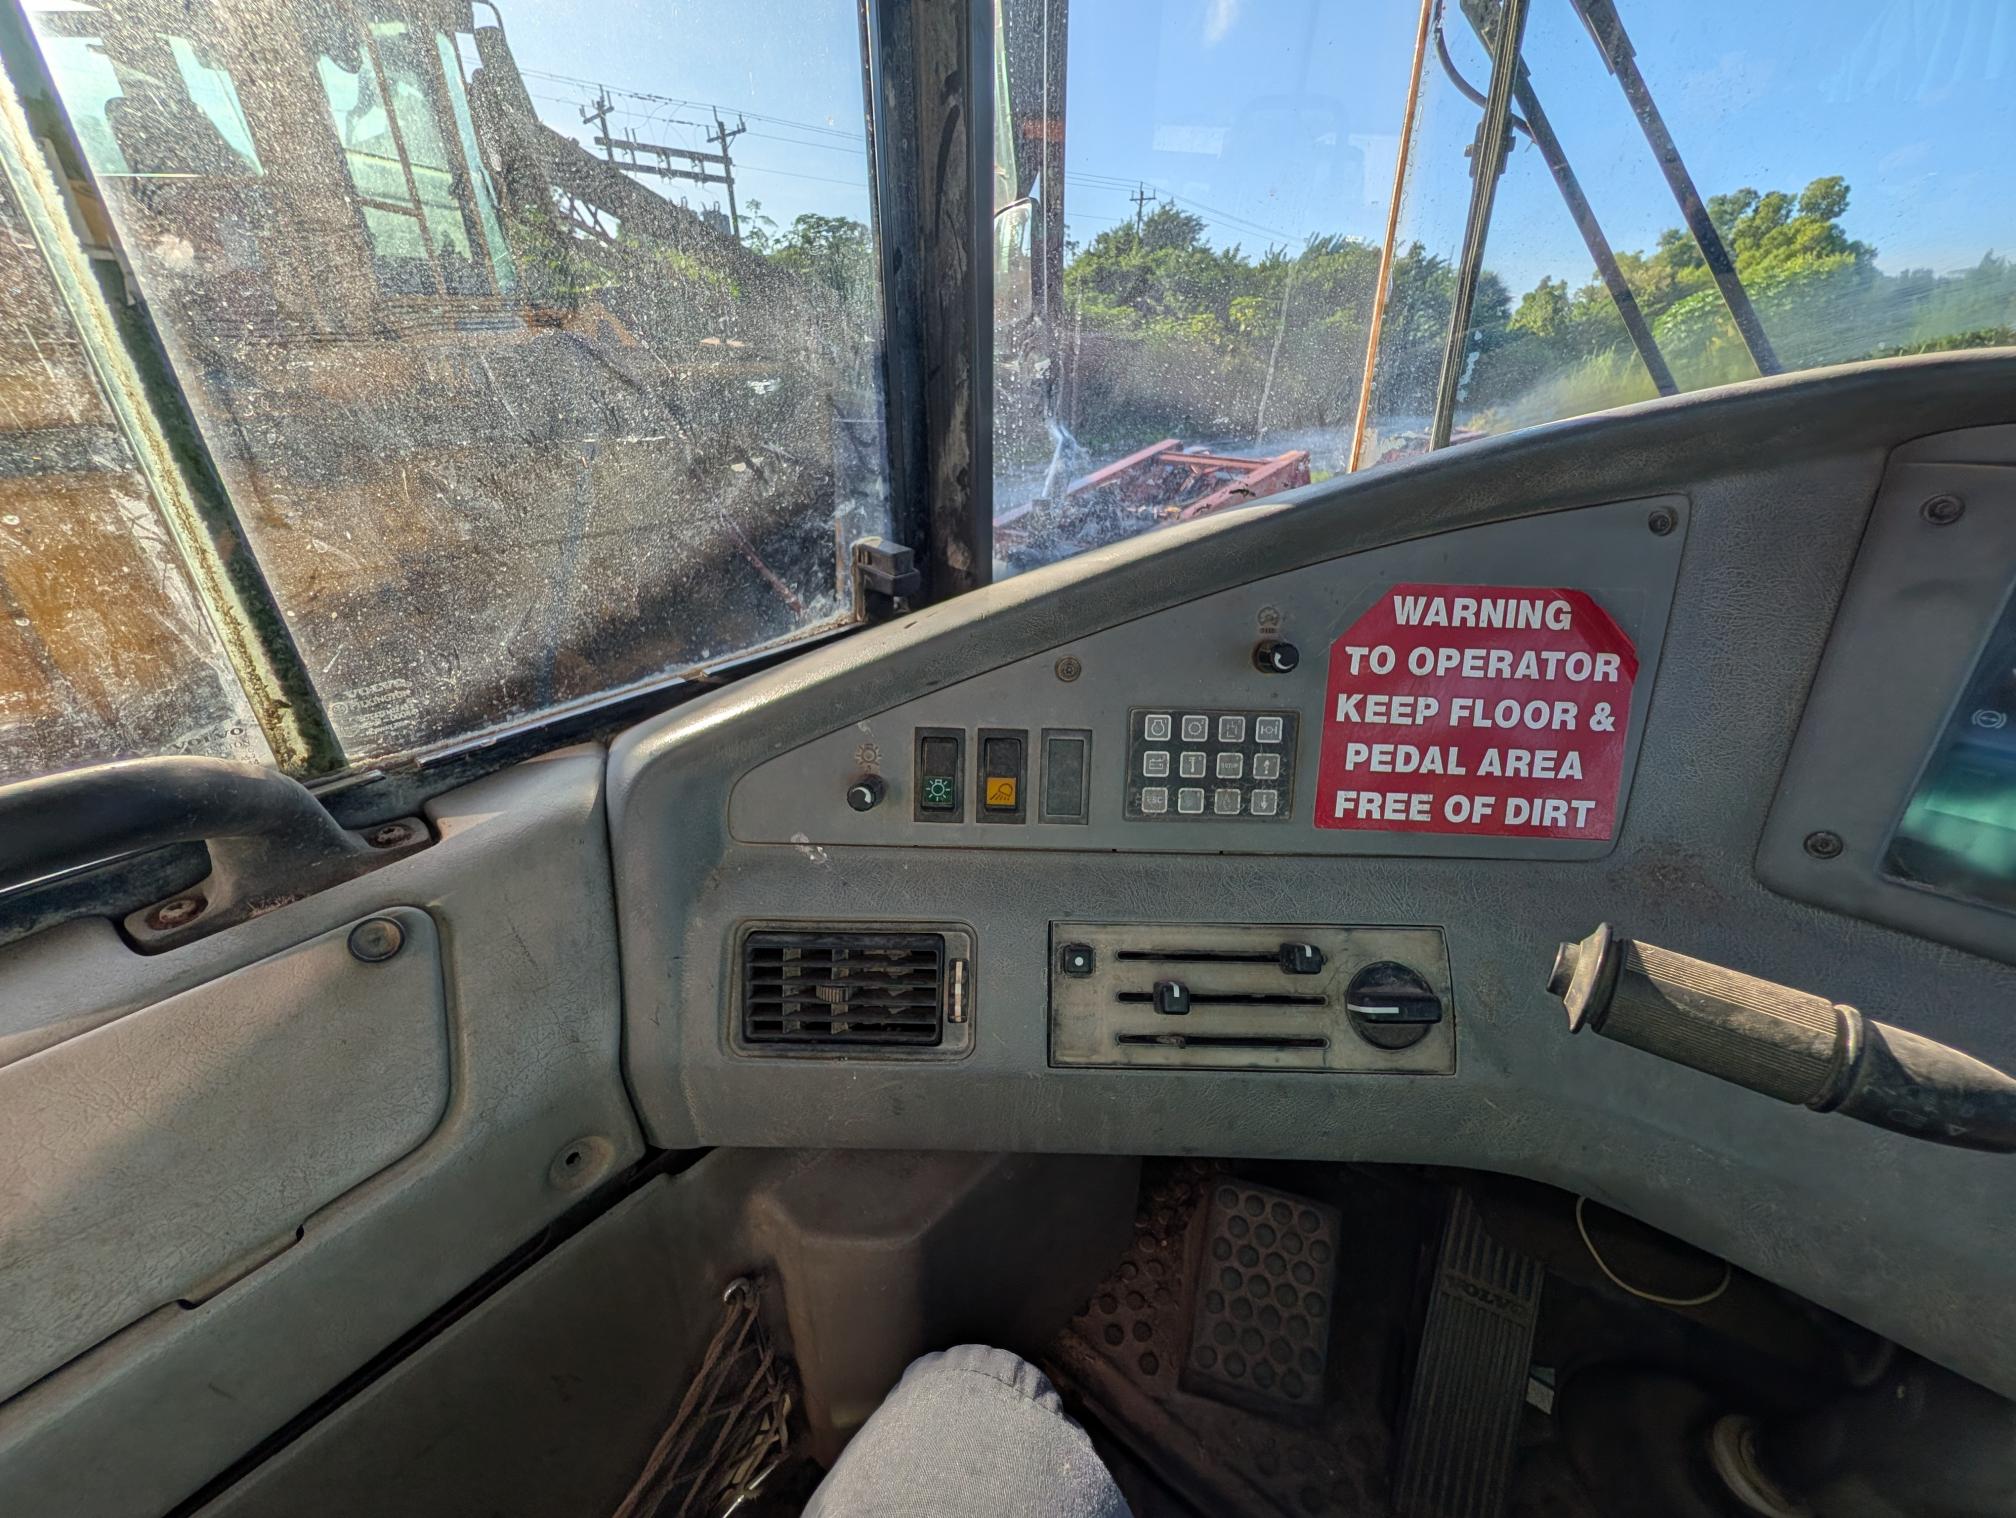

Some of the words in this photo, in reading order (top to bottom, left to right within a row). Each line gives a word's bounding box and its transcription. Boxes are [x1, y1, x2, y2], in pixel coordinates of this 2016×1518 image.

[1393, 595, 1573, 631] WARNING
[1345, 645, 1396, 676] TO
[1408, 646, 1621, 682] OPERATOR
[1335, 693, 1440, 726] KEEP
[1449, 697, 1578, 731] FLOOR
[1589, 701, 1615, 732] &
[171, 726, 244, 750] VOLVO
[1345, 742, 1466, 776] PEDAL
[1477, 748, 1583, 780] AREA
[1334, 790, 1433, 822] FREE
[1444, 795, 1496, 824] OF
[1504, 796, 1597, 828] DIRT
